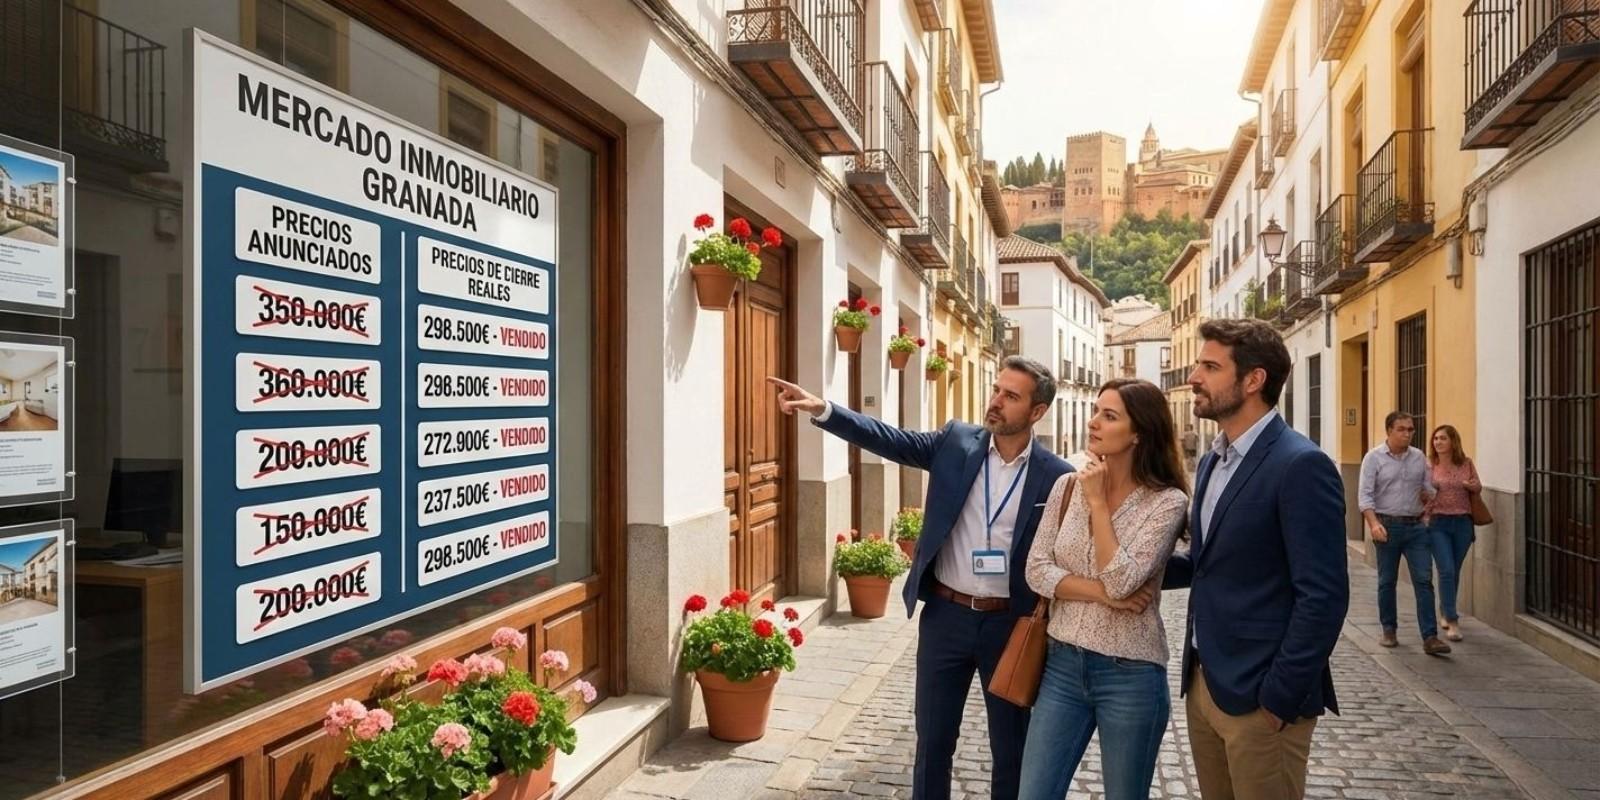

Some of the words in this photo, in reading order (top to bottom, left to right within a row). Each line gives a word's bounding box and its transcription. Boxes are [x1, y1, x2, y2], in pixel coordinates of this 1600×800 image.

[238, 73, 392, 163] MERCADO
[400, 139, 539, 219] INMOBILIARIO
[362, 167, 477, 232] GRANADA
[272, 205, 352, 245] PRECIOS
[248, 230, 372, 275] ANUNCIADOS
[432, 246, 484, 276] PRECIOS
[488, 261, 501, 280] DE
[504, 266, 540, 289] CIERRE
[468, 278, 510, 302] REALES
[258, 292, 367, 332] 350.000€
[424, 315, 490, 345] 298.500€
[500, 326, 545, 350] VENDIDO
[258, 367, 367, 398] 360.000€
[424, 374, 490, 397] 298.500€
[500, 377, 545, 397] VENDIDO
[258, 436, 367, 474] 200.000€
[424, 429, 490, 456] 272.900€
[424, 481, 490, 514] 237.500€
[501, 473, 546, 498] VENDIDO
[260, 501, 367, 547] 150.000€
[424, 534, 490, 574] 298.500€
[501, 521, 546, 550] VENDIDO
[259, 566, 367, 624] 200.000€
